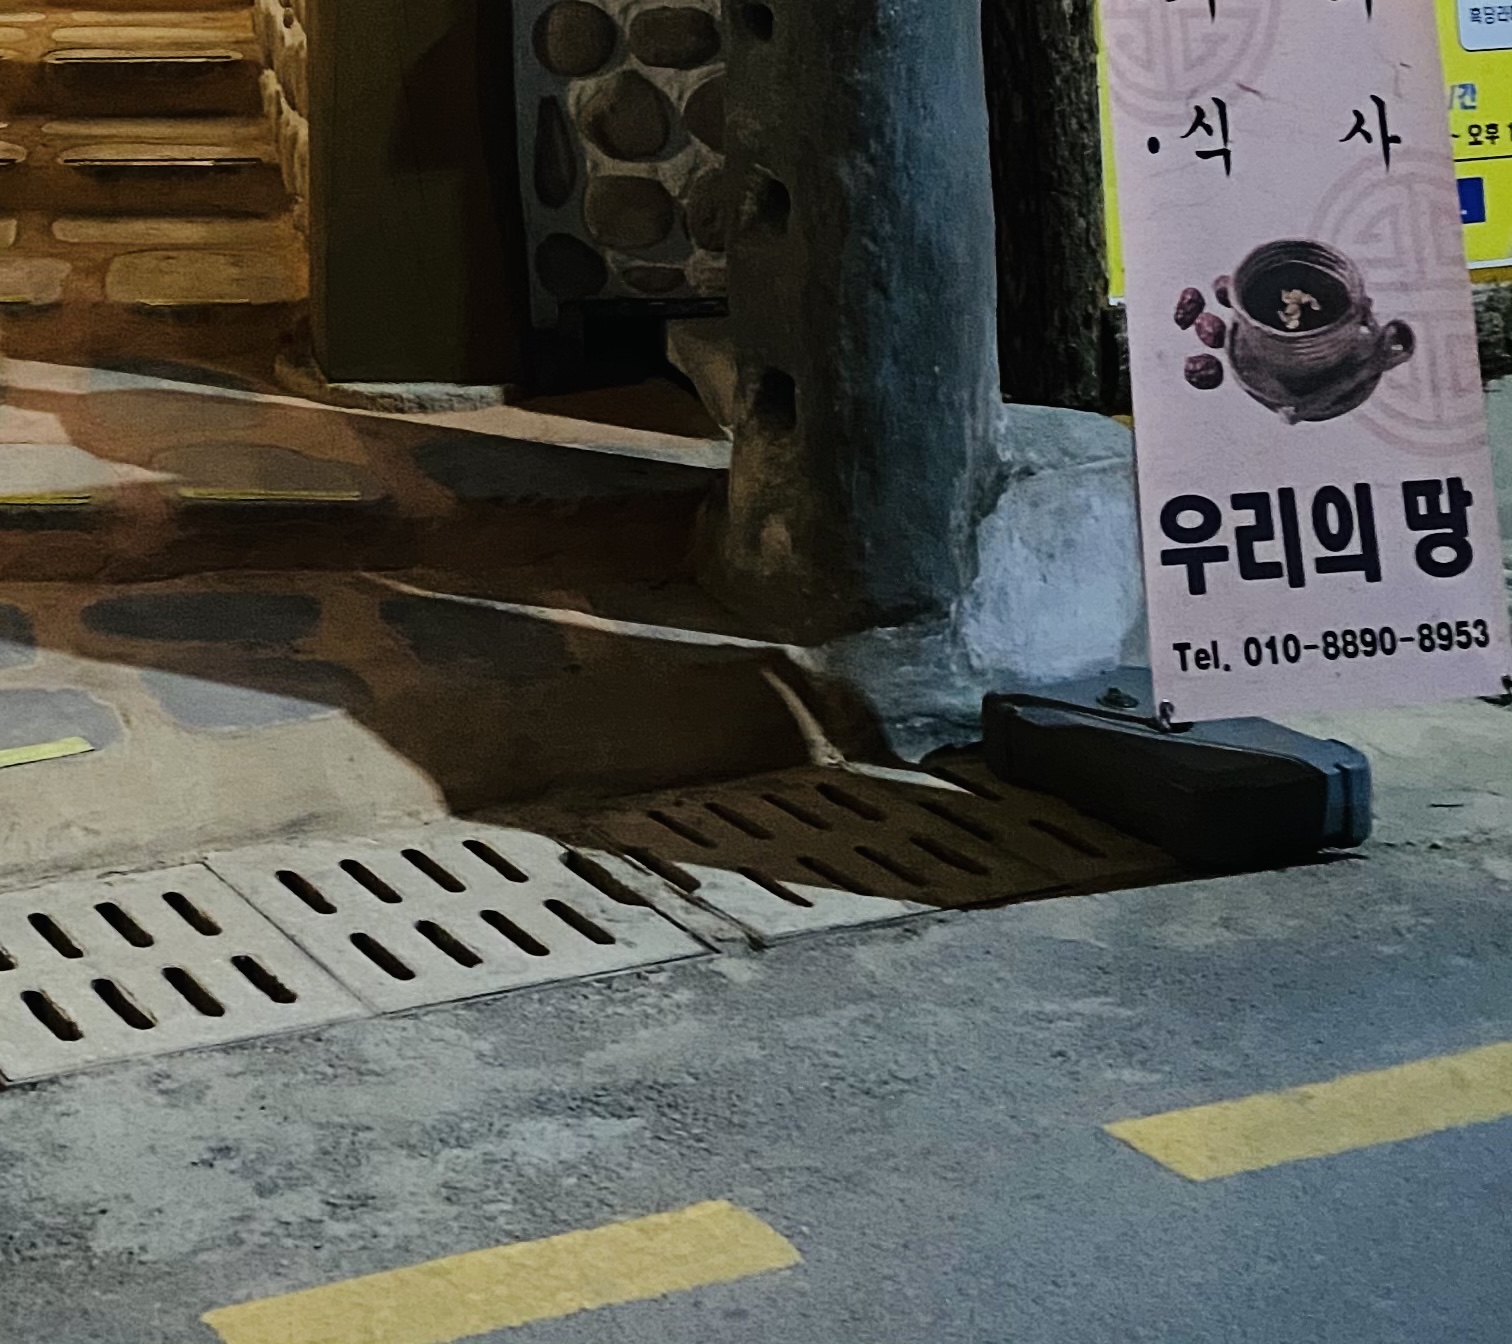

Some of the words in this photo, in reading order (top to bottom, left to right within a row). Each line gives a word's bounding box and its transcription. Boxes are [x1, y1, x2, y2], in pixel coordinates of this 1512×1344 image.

[1468, 123, 1500, 146] 오후
[1159, 483, 1382, 596] 우리의
[1401, 476, 1473, 579] 땅
[1173, 640, 1232, 673] Tel.
[1243, 618, 1490, 666] 010-8890-8953
